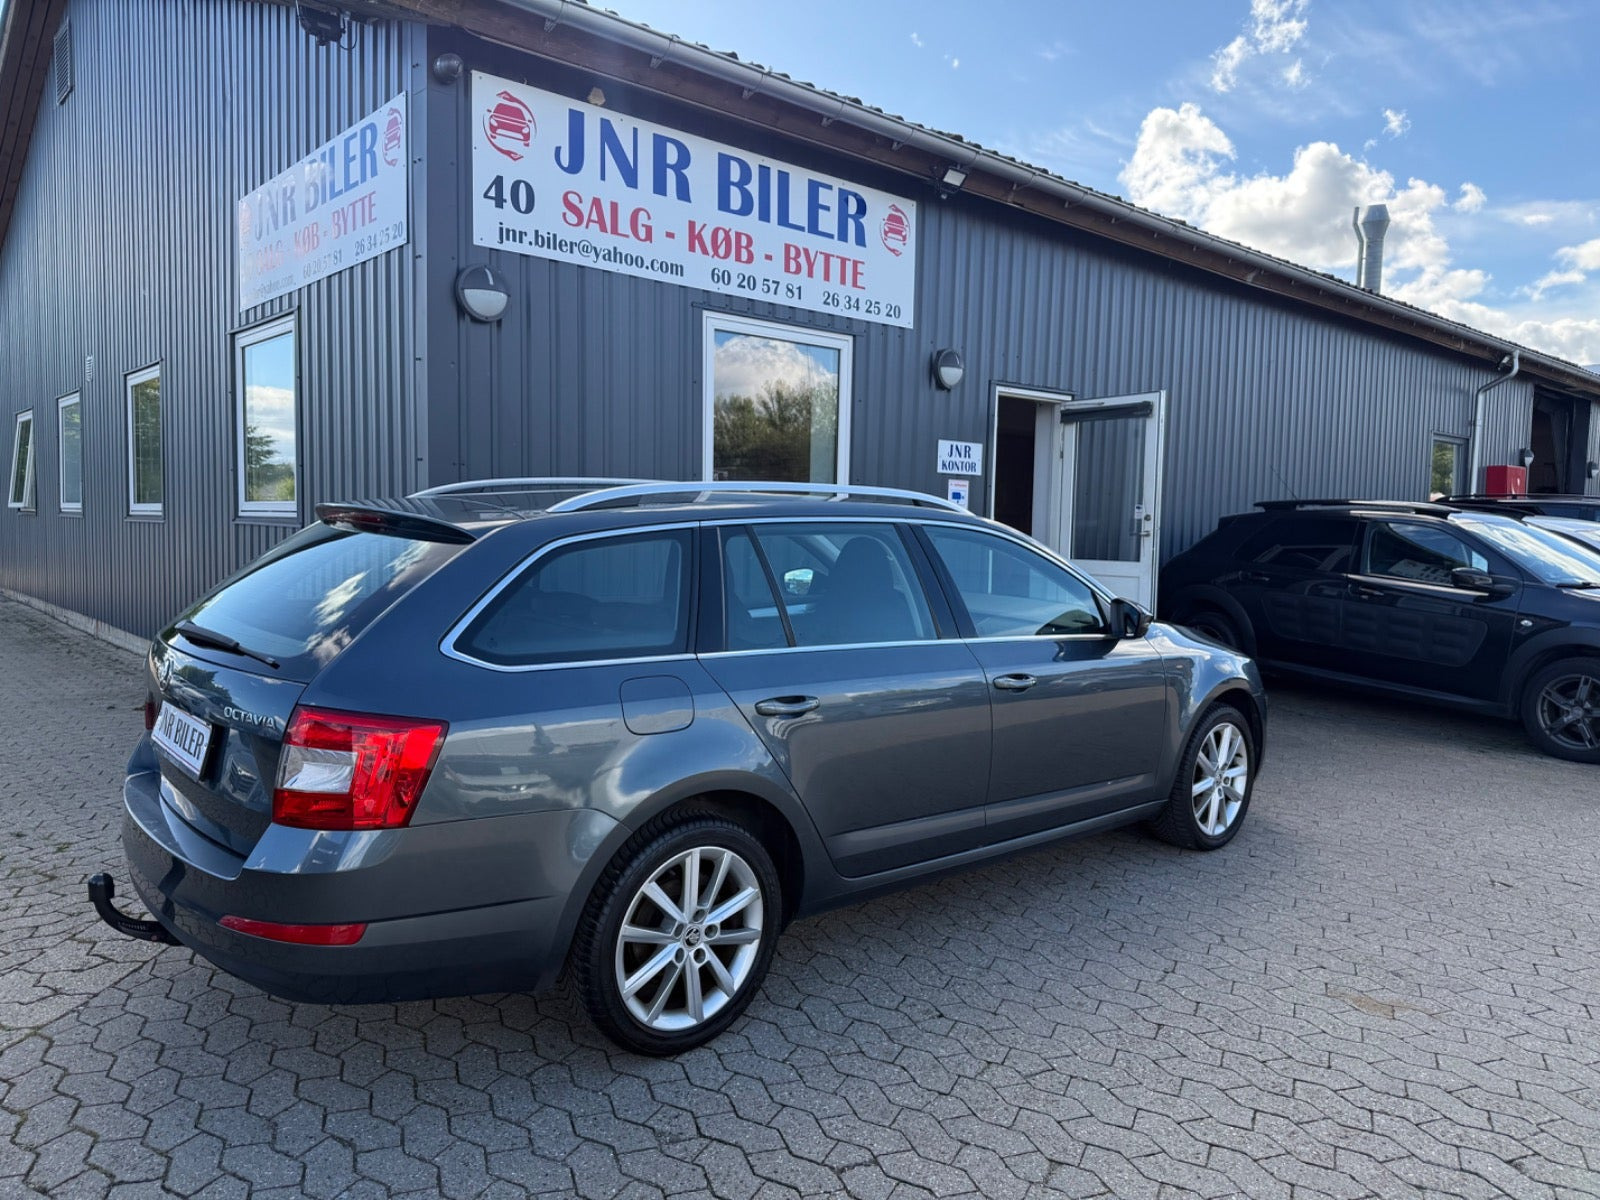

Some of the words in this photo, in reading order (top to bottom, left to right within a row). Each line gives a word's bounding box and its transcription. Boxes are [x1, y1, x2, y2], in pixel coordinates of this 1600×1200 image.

[304, 121, 379, 215] BILER
[554, 108, 692, 204] JNR
[717, 151, 867, 248] BILER
[332, 191, 377, 239] BYTTE
[483, 175, 535, 215] 40
[333, 248, 342, 266] 81
[354, 239, 365, 257] 26
[367, 233, 377, 251] 34
[392, 220, 403, 241] 20
[497, 222, 684, 277] jnr.biler@yahoo.com
[562, 190, 653, 244] SALG
[688, 219, 755, 265] KØB
[783, 242, 866, 290] BYTTE
[711, 267, 731, 286] 60
[736, 272, 757, 291] 20
[761, 278, 780, 296] 57
[785, 283, 802, 300] 81
[822, 290, 840, 308] 26
[843, 295, 860, 312] 34
[864, 299, 881, 316] 25
[885, 303, 901, 319] 20
[941, 459, 977, 473] KONTOR
[948, 443, 971, 459] JNR
[174, 718, 205, 760] BILER
[223, 706, 277, 729] OCTAVIA
